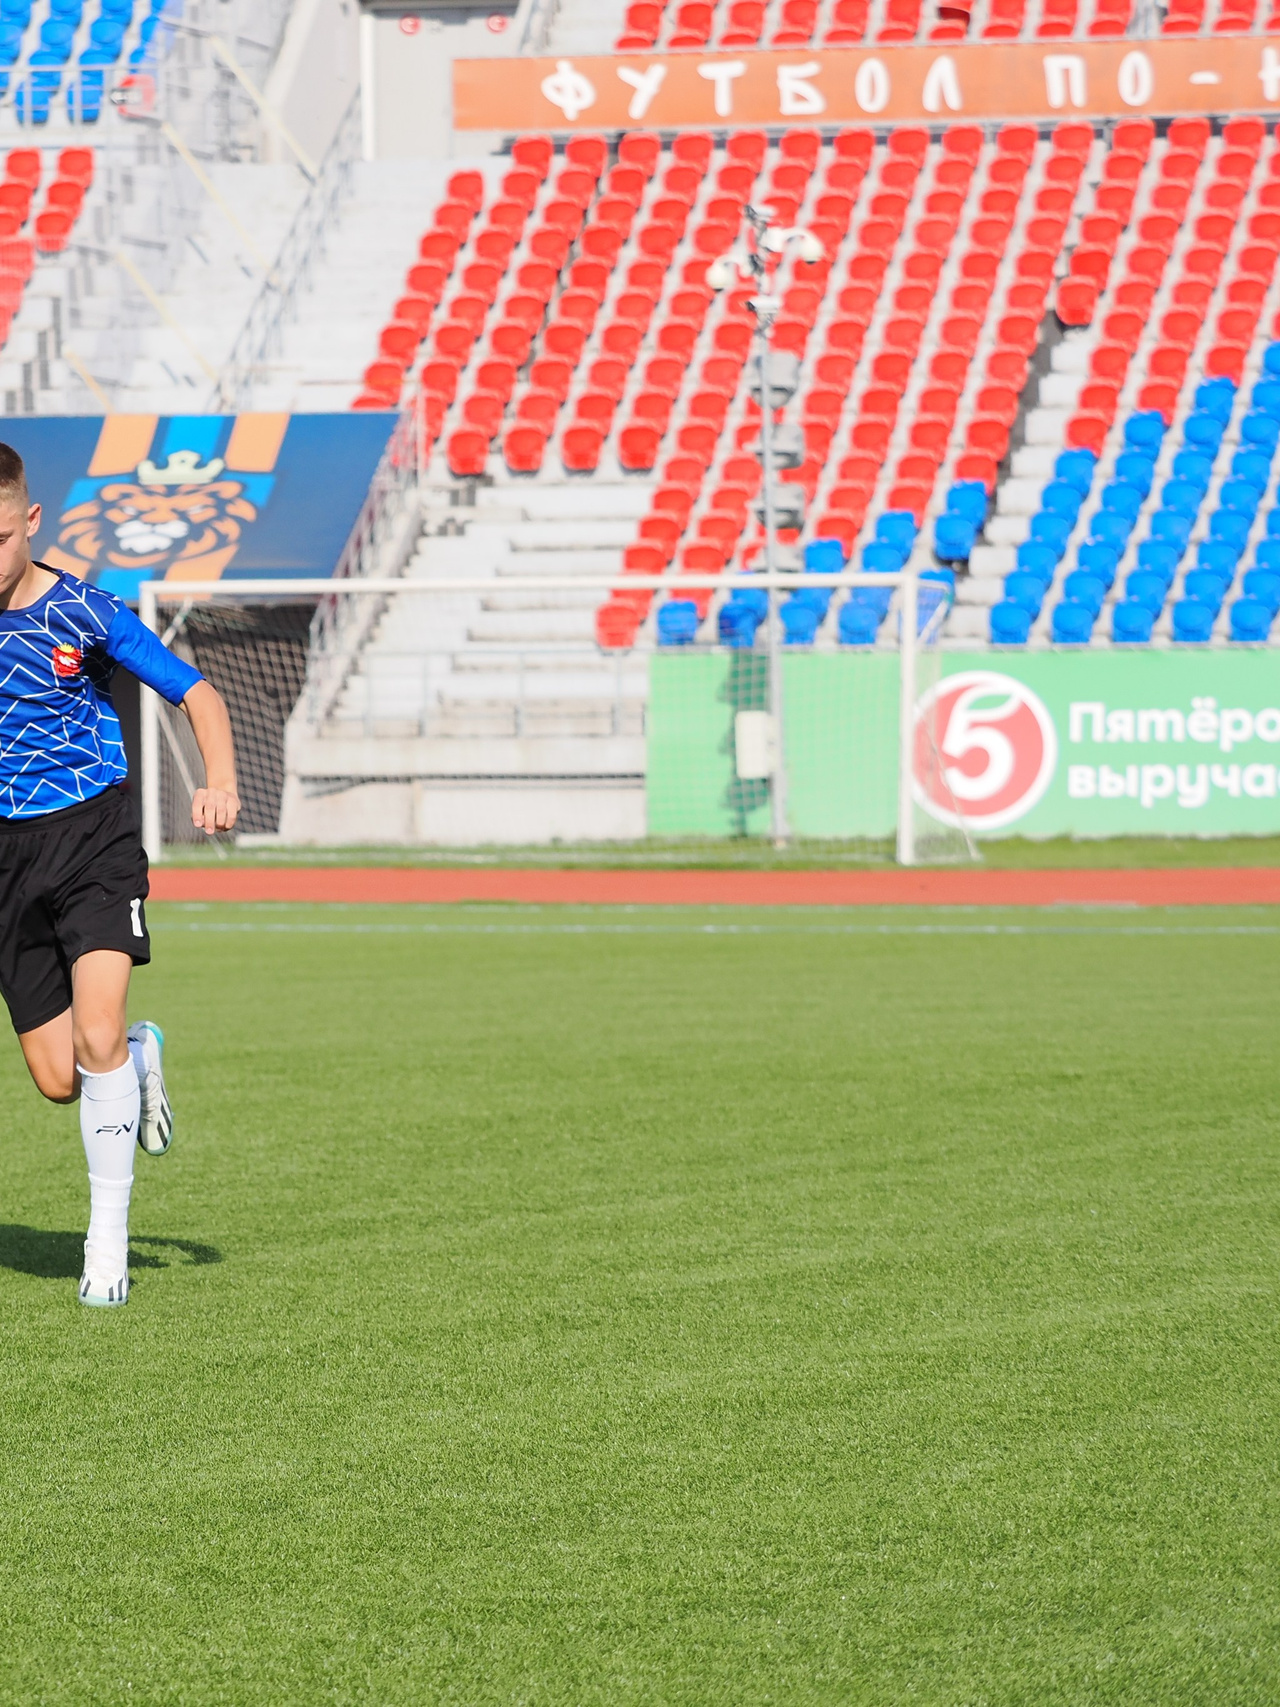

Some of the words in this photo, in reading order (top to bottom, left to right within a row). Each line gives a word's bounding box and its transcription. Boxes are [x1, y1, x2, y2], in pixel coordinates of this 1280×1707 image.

[540, 55, 963, 121] ФУТБОЛ
[1069, 763, 1280, 809] выруча
[129, 897, 144, 938] 1
